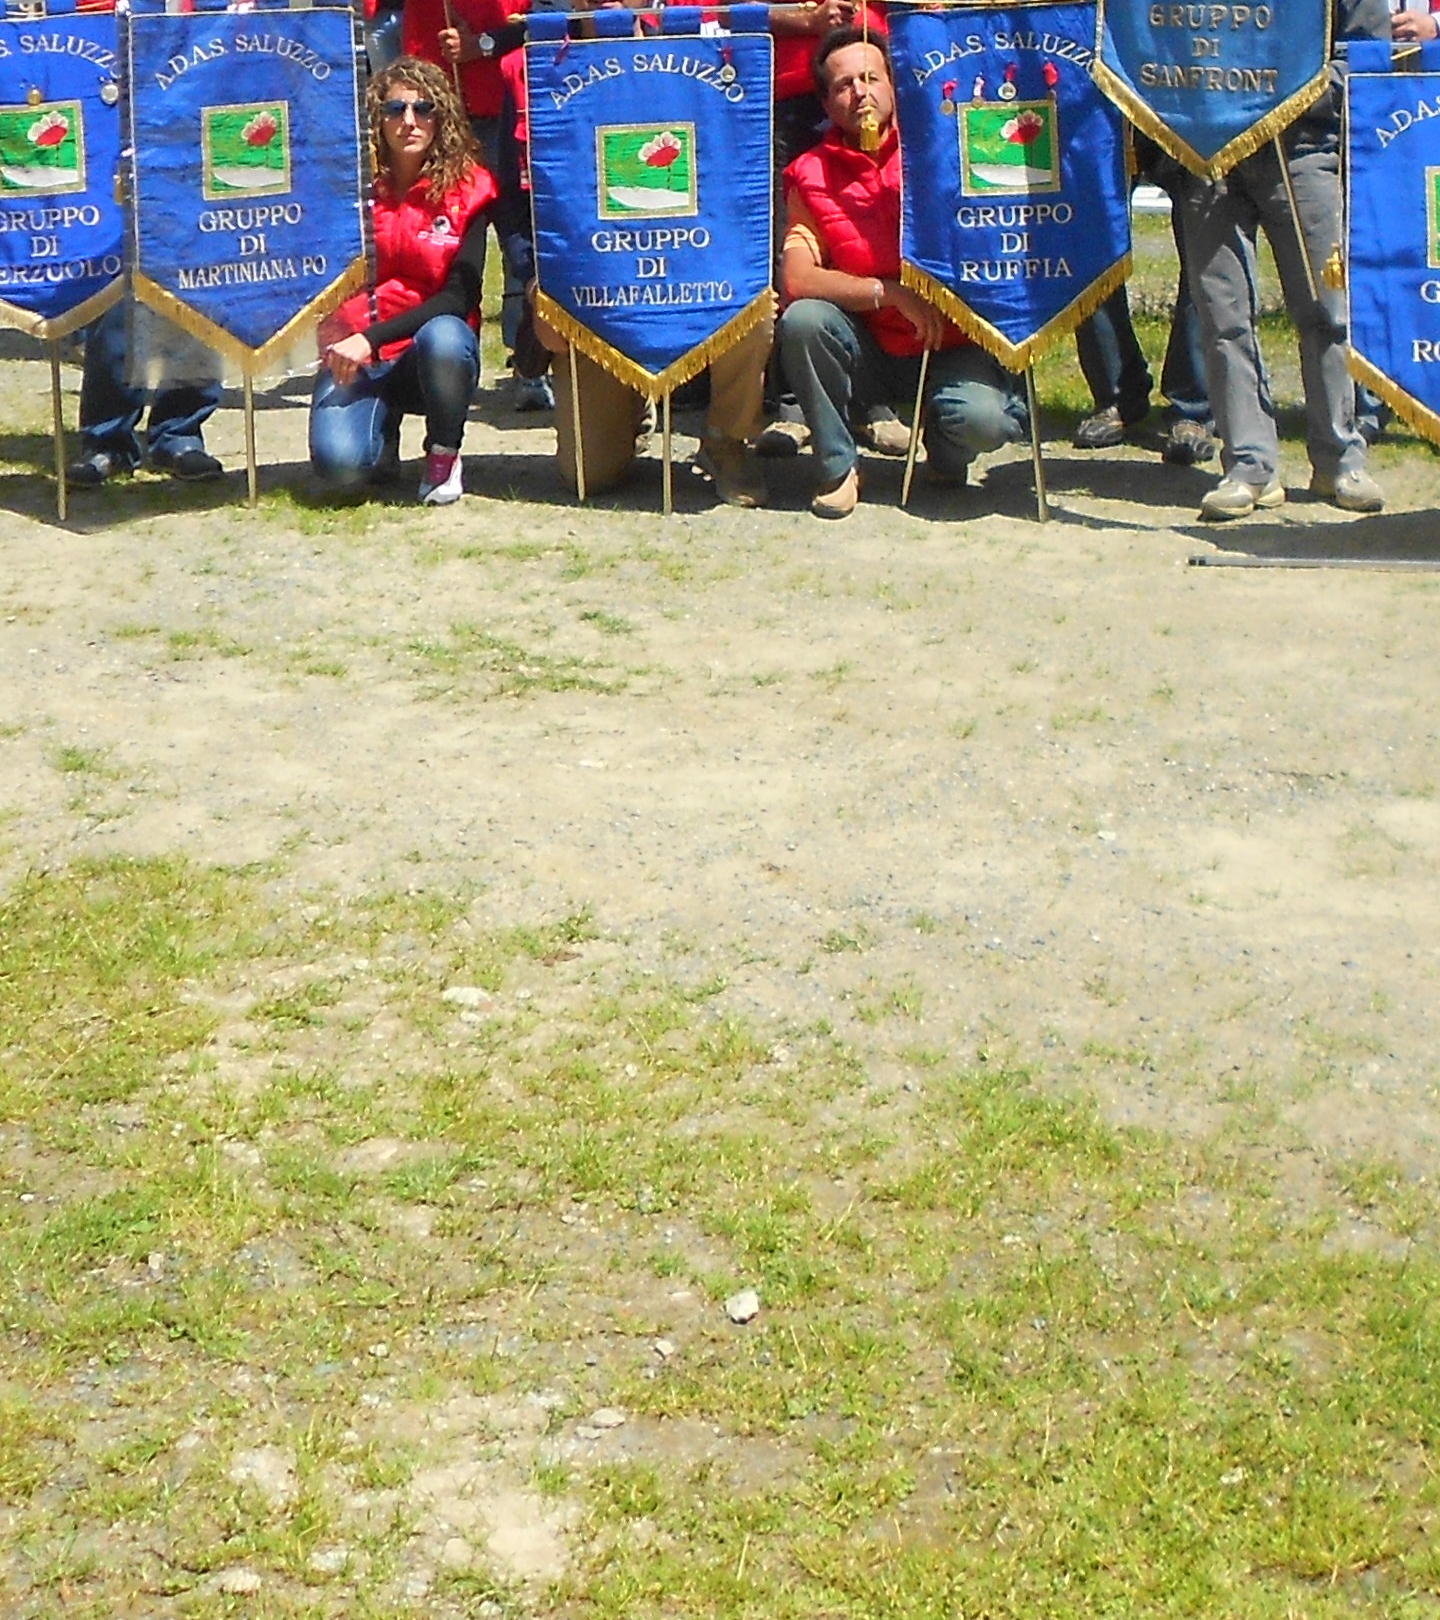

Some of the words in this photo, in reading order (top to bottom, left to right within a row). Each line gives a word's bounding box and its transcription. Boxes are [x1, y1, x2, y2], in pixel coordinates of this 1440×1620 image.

[1147, 3, 1274, 32] GRUPPO
[153, 38, 230, 92] A.D.A.S.
[234, 33, 333, 82] SALUZZO
[1191, 37, 1221, 59] DI
[547, 57, 628, 111] A.D.A.S.
[632, 53, 747, 105] SALUZZO
[1138, 62, 1281, 96] SANFRONT
[197, 201, 304, 234] GRUPPO
[956, 203, 1074, 230] GRUPPO
[29, 235, 60, 260] DI
[238, 233, 268, 257] DI
[590, 225, 712, 254] GRUPPO
[1000, 231, 1031, 256] DI
[177, 256, 297, 290] MARTINIANA
[301, 254, 328, 278] PO
[635, 255, 669, 279] DI
[959, 256, 1074, 283] RUFFIA
[570, 280, 734, 309] VILLAFALLETTO
